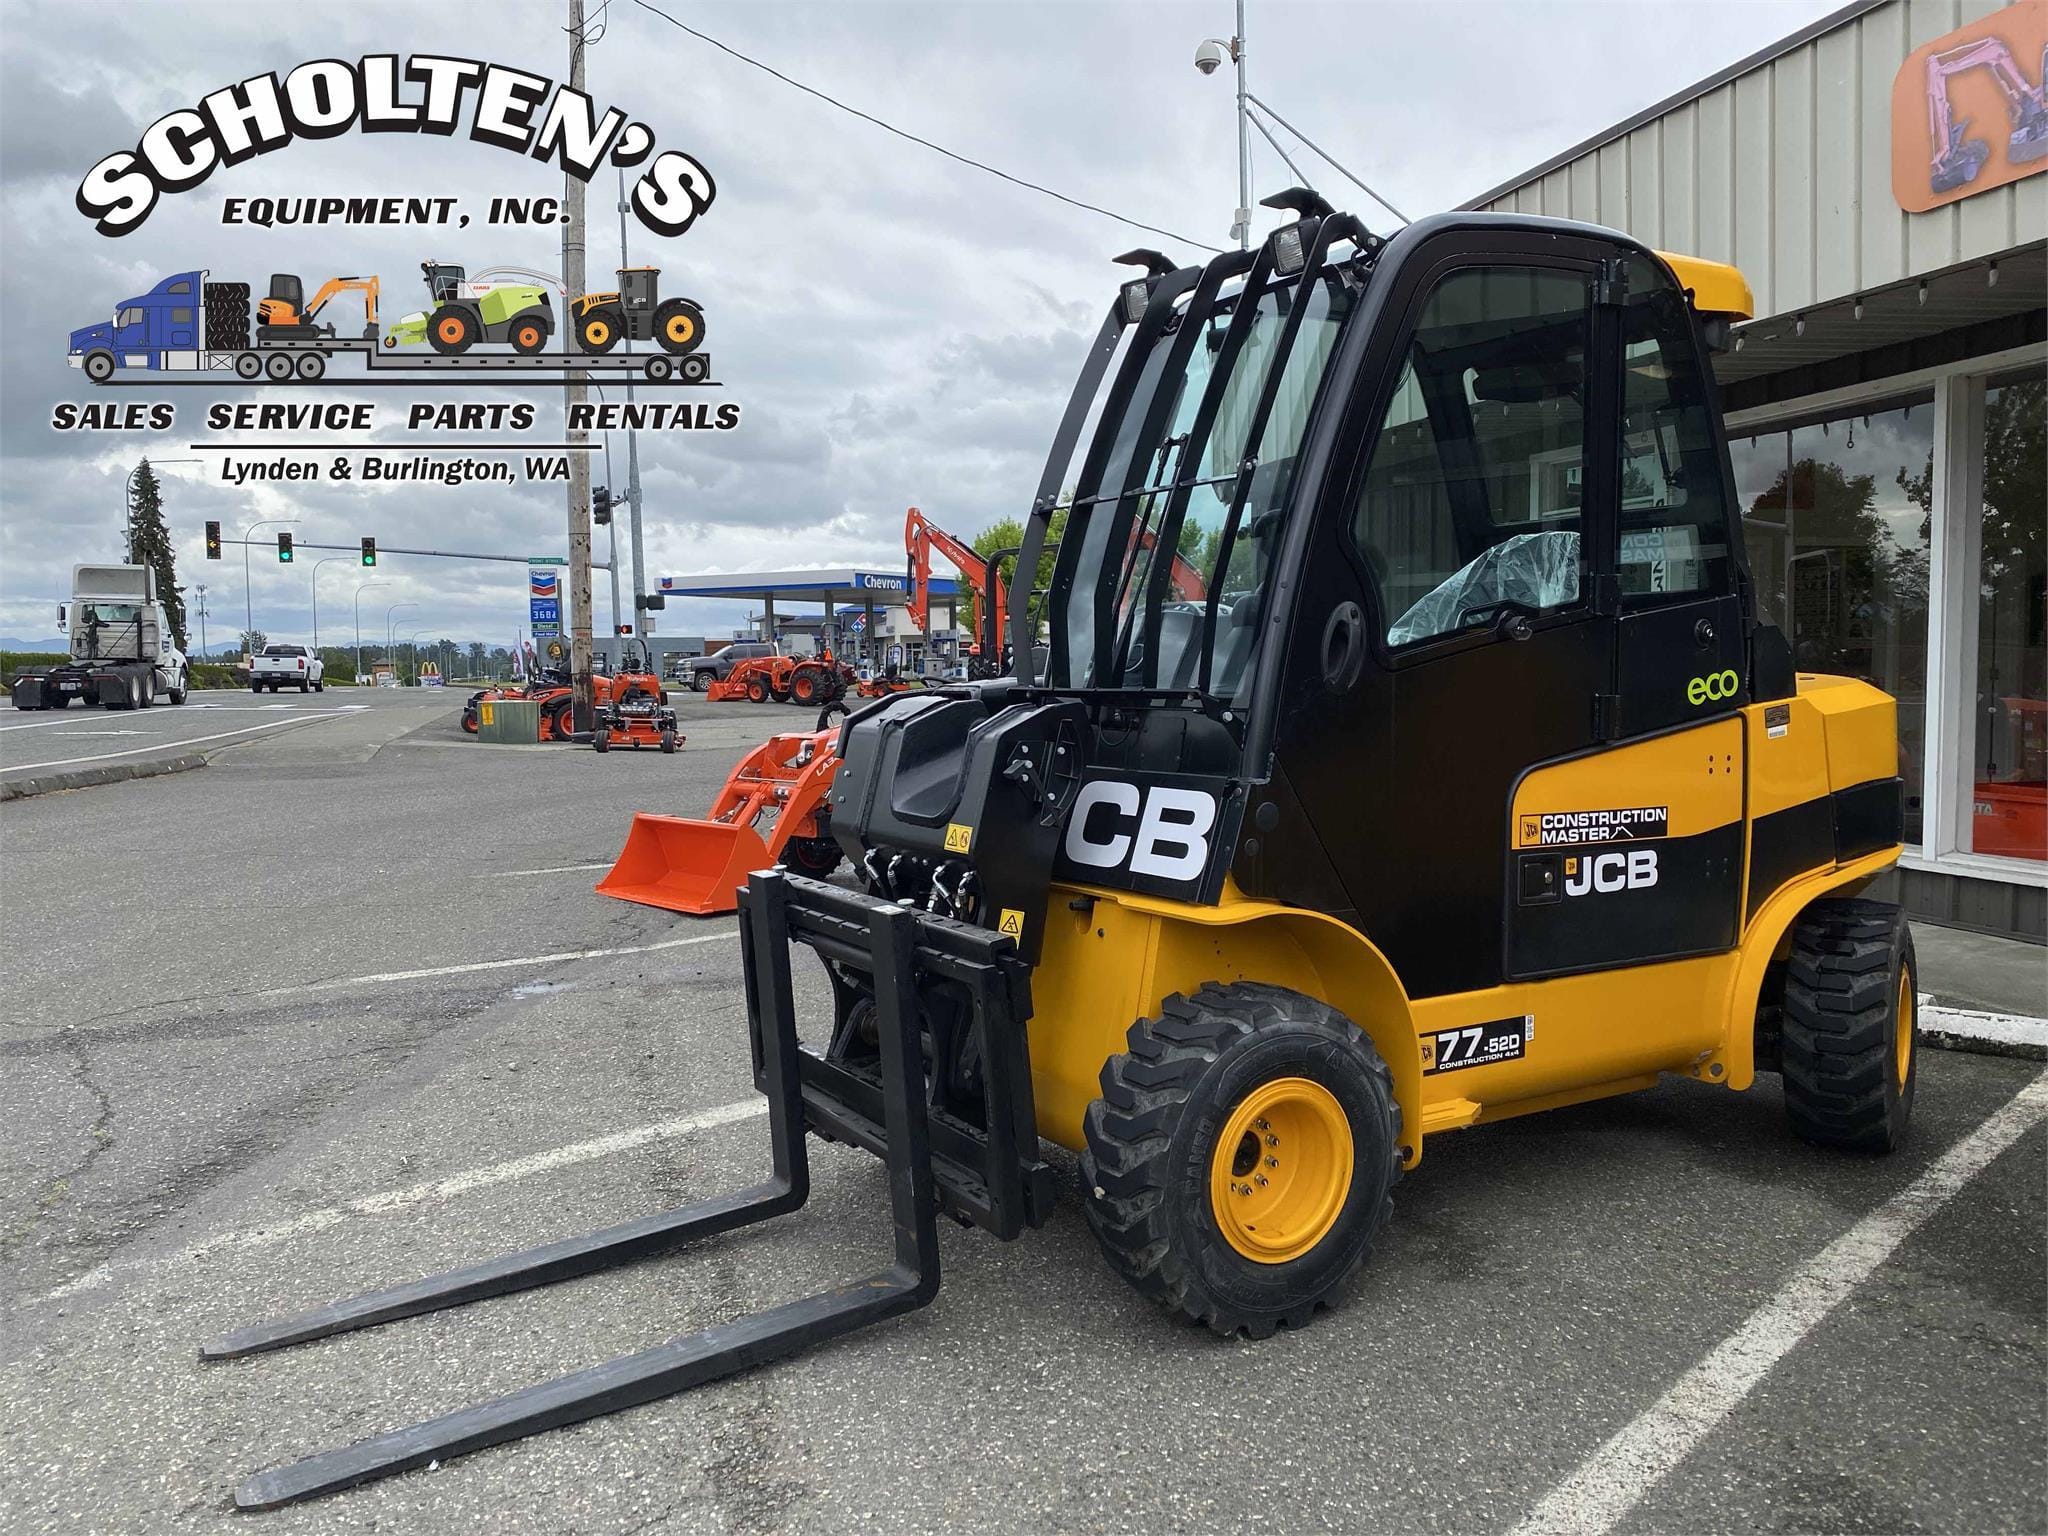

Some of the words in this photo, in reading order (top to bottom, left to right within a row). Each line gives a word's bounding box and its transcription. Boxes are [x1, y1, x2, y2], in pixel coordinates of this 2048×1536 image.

[864, 574, 902, 590] Chevron
[1687, 669, 1739, 705] eco
[1542, 808, 1667, 829] CONSTRUCTION
[1065, 780, 1216, 881] CB
[1541, 826, 1610, 845] MASTER
[1565, 849, 1658, 897] JCB
[1439, 1053, 1503, 1070] CONSTRUCTION
